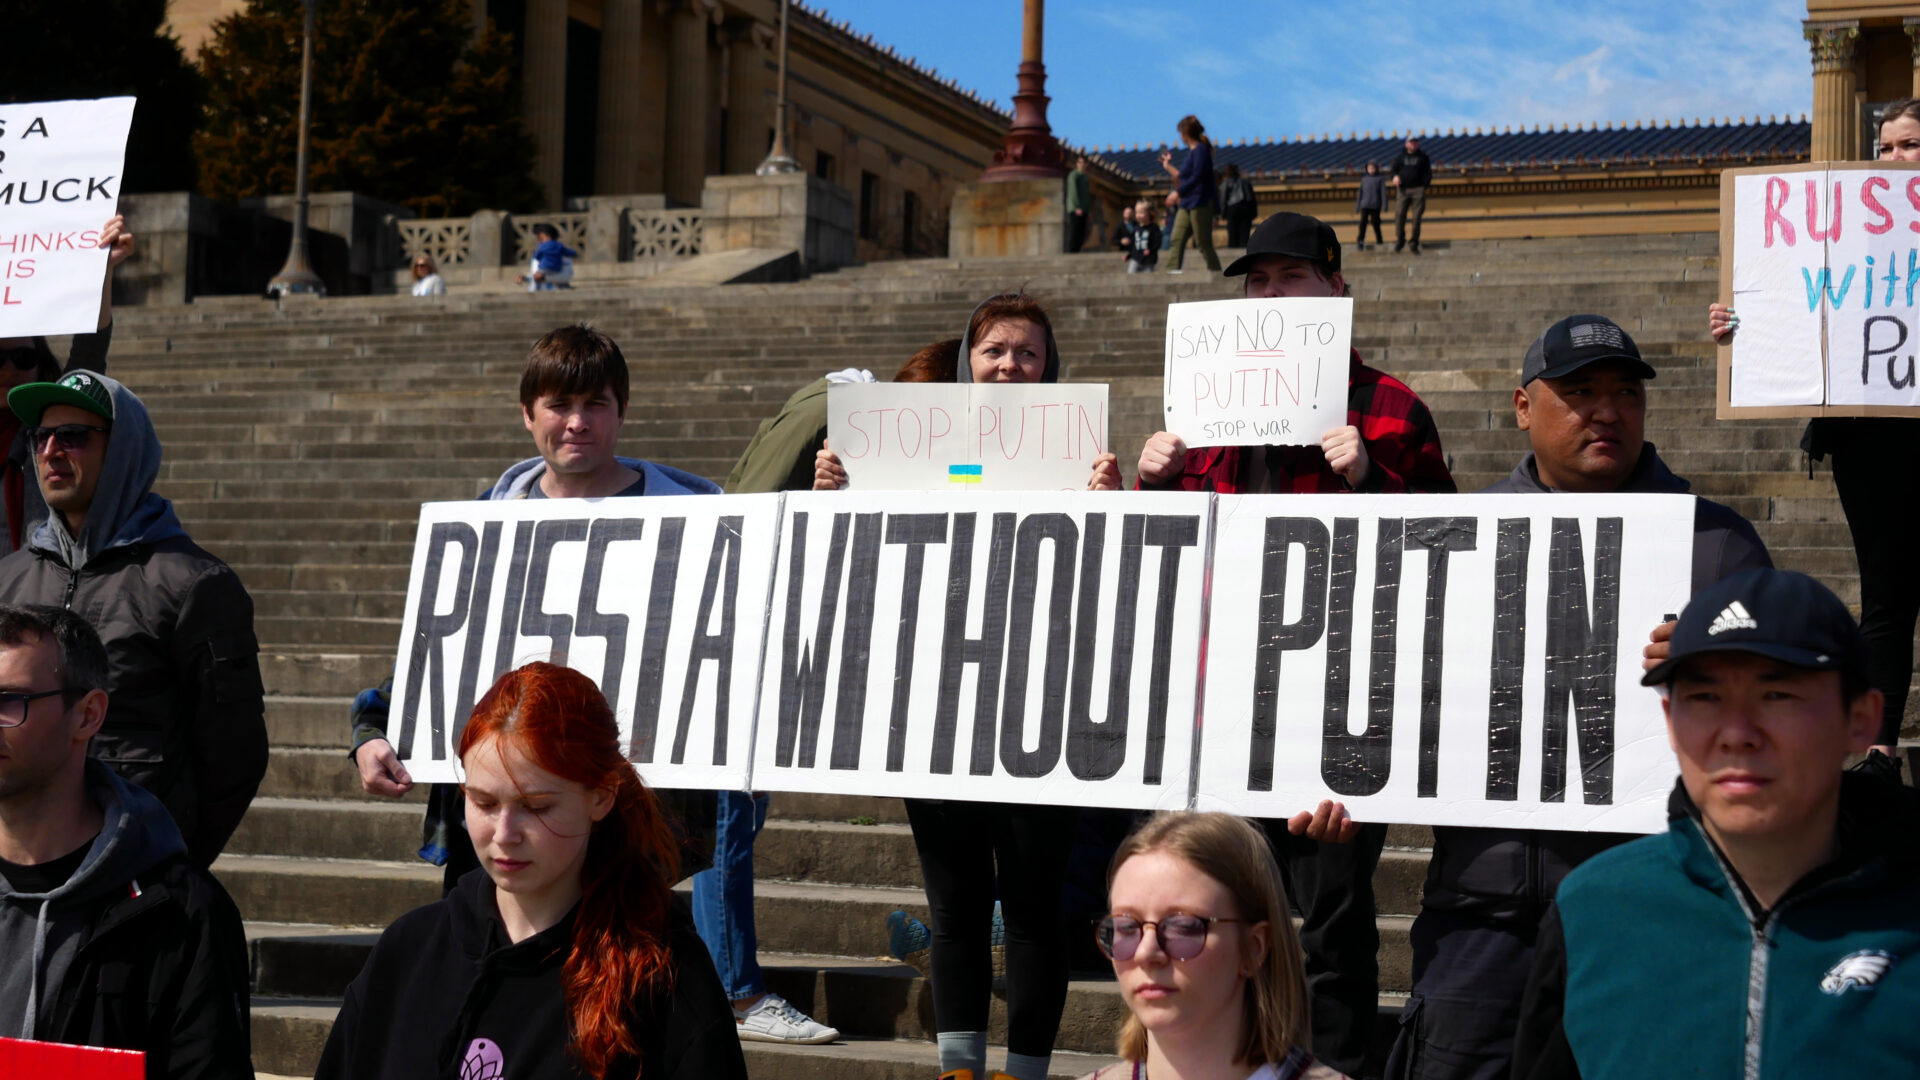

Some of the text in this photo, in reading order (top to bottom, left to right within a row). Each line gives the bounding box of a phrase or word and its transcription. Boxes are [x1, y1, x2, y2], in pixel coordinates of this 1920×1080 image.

[21, 117, 49, 139] A
[6, 259, 36, 280] IS
[1177, 309, 1335, 359] SAY NO TO
[1861, 315, 1916, 390] Pu
[843, 401, 1103, 460] STOP PUTIN
[1203, 420, 1246, 439] STOP
[397, 511, 1623, 805] RUSSIA WITHOUT PUTIN
